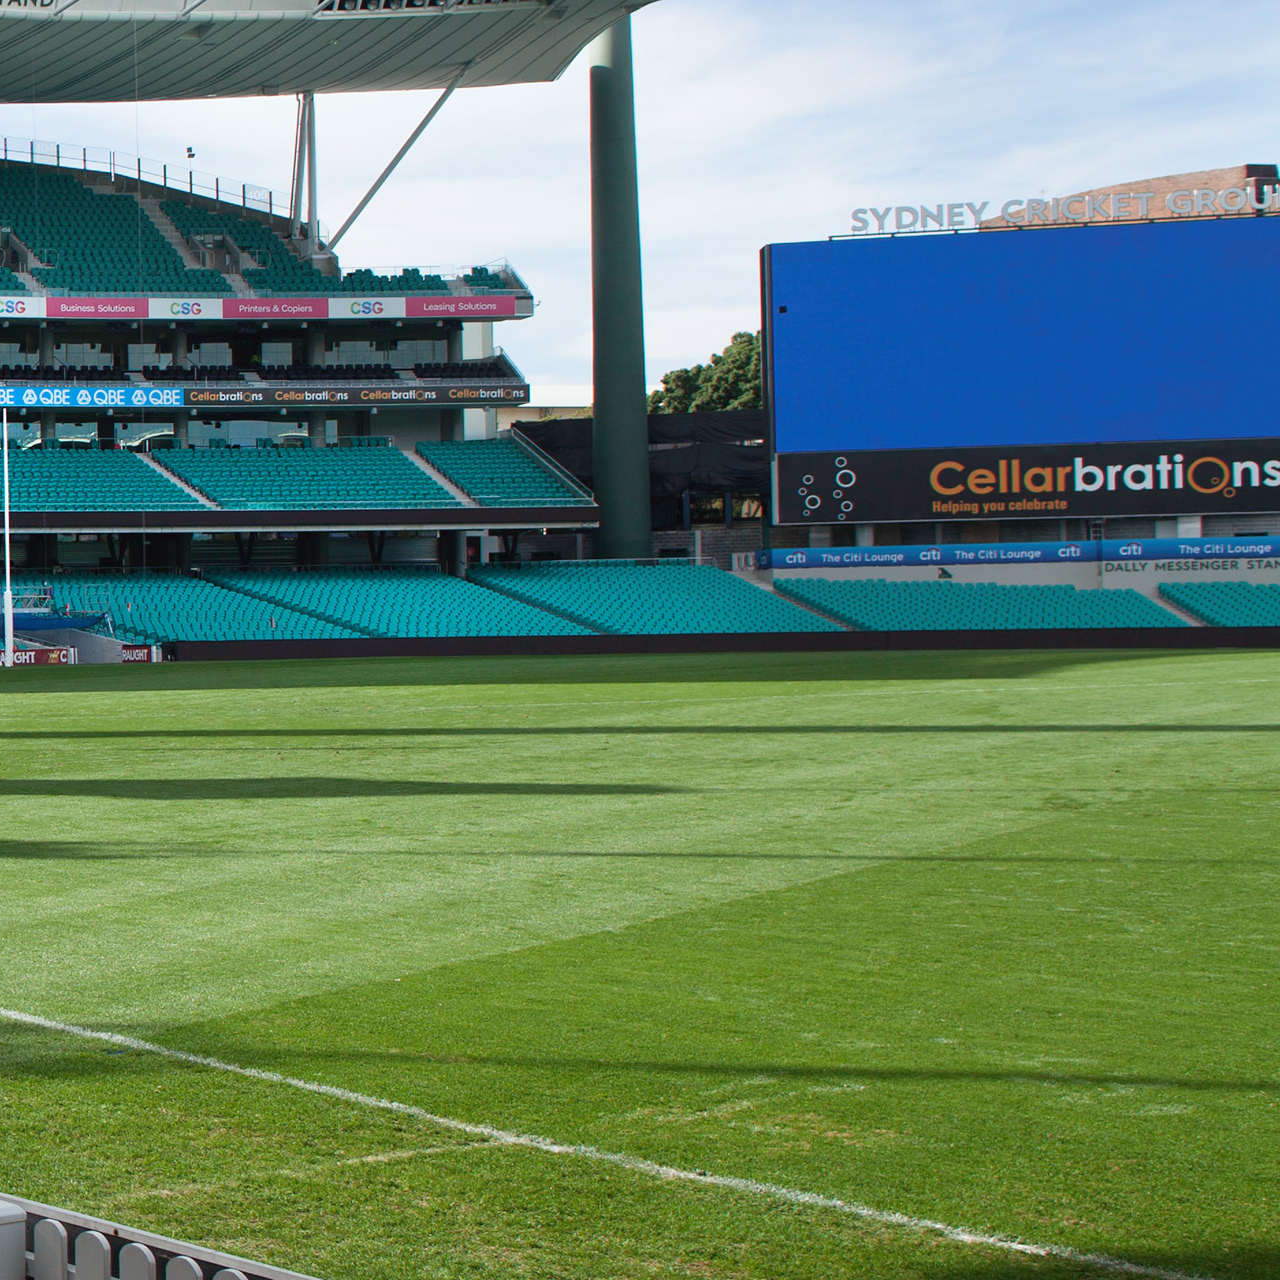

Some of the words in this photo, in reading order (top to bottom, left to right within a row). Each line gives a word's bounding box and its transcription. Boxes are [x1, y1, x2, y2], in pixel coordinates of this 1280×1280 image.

[851, 201, 989, 232] SYDNEY
[1001, 192, 1156, 224] CRICKET
[60, 303, 95, 313] Business
[98, 303, 135, 313] Solutions
[170, 302, 202, 315] CSG
[239, 304, 271, 313] Printers
[272, 304, 279, 313] &
[281, 304, 313, 315] Copiers
[350, 301, 384, 315] CSG
[423, 302, 456, 312] Leasing
[458, 301, 497, 311] Solutions
[39, 389, 70, 405] QBE
[94, 389, 125, 405] QBE
[149, 389, 181, 405] QBE
[932, 500, 979, 514] Helping
[982, 501, 1005, 513] you
[1008, 499, 1068, 511] celebrate
[919, 547, 940, 561] citi
[954, 550, 976, 559] The
[978, 550, 997, 559] Citi
[1000, 549, 1041, 560] Lounge
[1058, 544, 1081, 558] citi
[1119, 542, 1142, 556] citi
[1179, 544, 1202, 554] The
[1204, 543, 1225, 554] Citi
[1228, 543, 1272, 555] Lounge
[786, 550, 806, 564] citi
[821, 553, 840, 563] The
[843, 553, 862, 563] Citi
[865, 553, 904, 564] Lounge
[1104, 562, 1147, 572] DALLY
[1154, 560, 1238, 571] MESSENGER
[122, 649, 148, 661] RAUGHT
